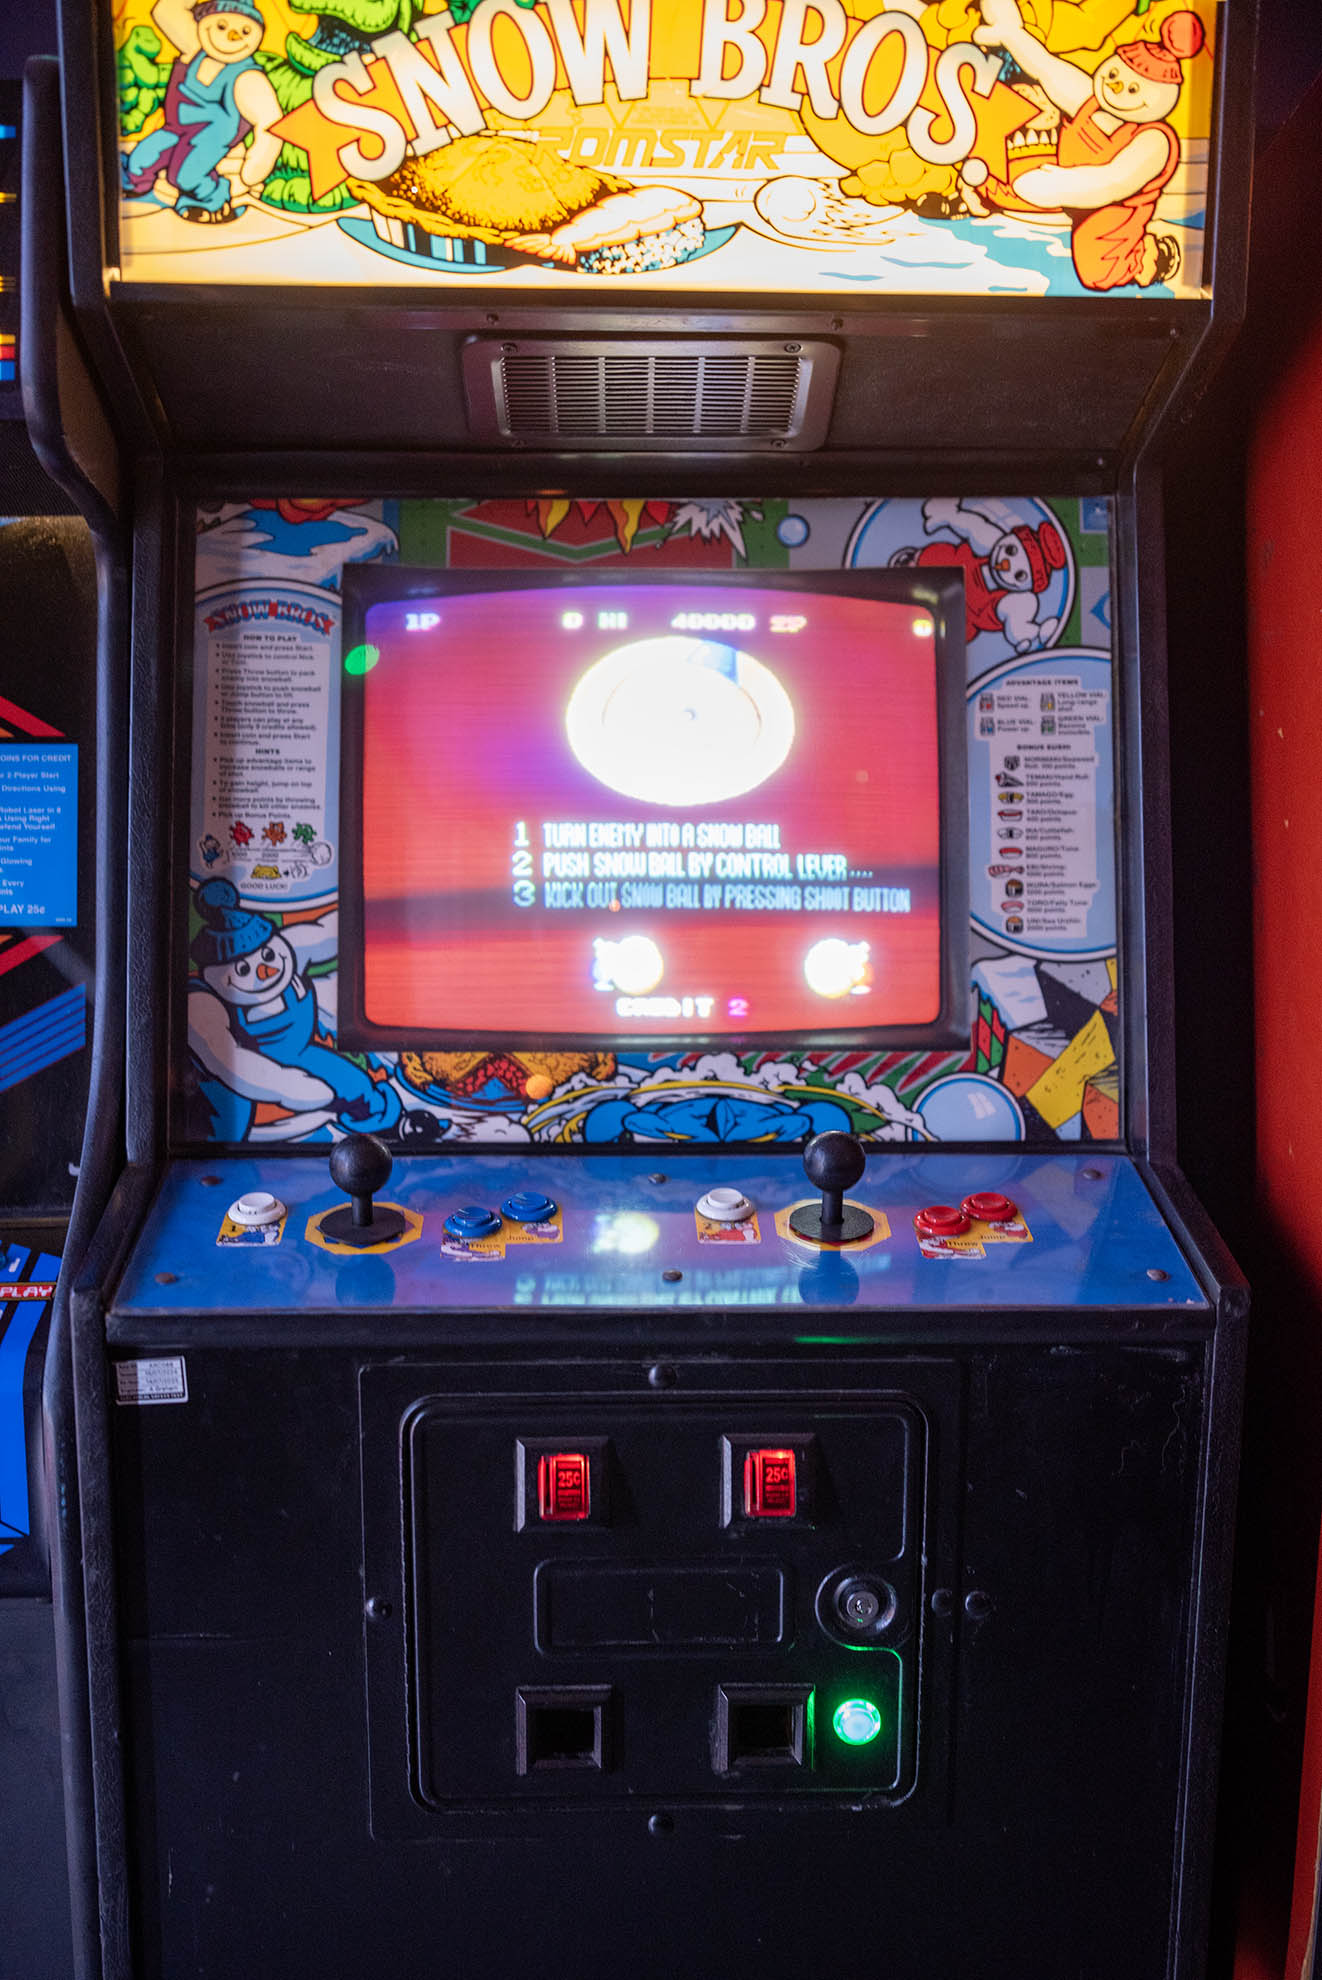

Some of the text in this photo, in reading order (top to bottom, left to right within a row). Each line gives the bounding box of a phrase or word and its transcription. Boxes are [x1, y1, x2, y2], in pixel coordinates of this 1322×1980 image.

[312, 0, 1004, 182] SNOW BROS
[536, 127, 787, 170] ROMSTAR
[406, 613, 441, 631] 1P
[671, 613, 756, 631] 40000
[22, 754, 40, 762] FOR
[42, 753, 72, 762] CREDIT
[41, 771, 59, 779] Start
[43, 785, 66, 794] Using
[514, 821, 781, 849] 1 TURN ENEMY INTO A SNOW BALL
[511, 850, 533, 877] 2
[542, 852, 590, 878] PUSH
[592, 852, 647, 878] SNOW
[648, 852, 686, 878] BALL
[687, 852, 714, 878] BY
[715, 852, 793, 880] CONTROL
[513, 880, 911, 912] 3 KICK OUT SNOW BALL BY PRESSING SHOOT BUTTON
[616, 996, 748, 1018] CREDIT 2
[0, 1286, 53, 1297] PLAY
